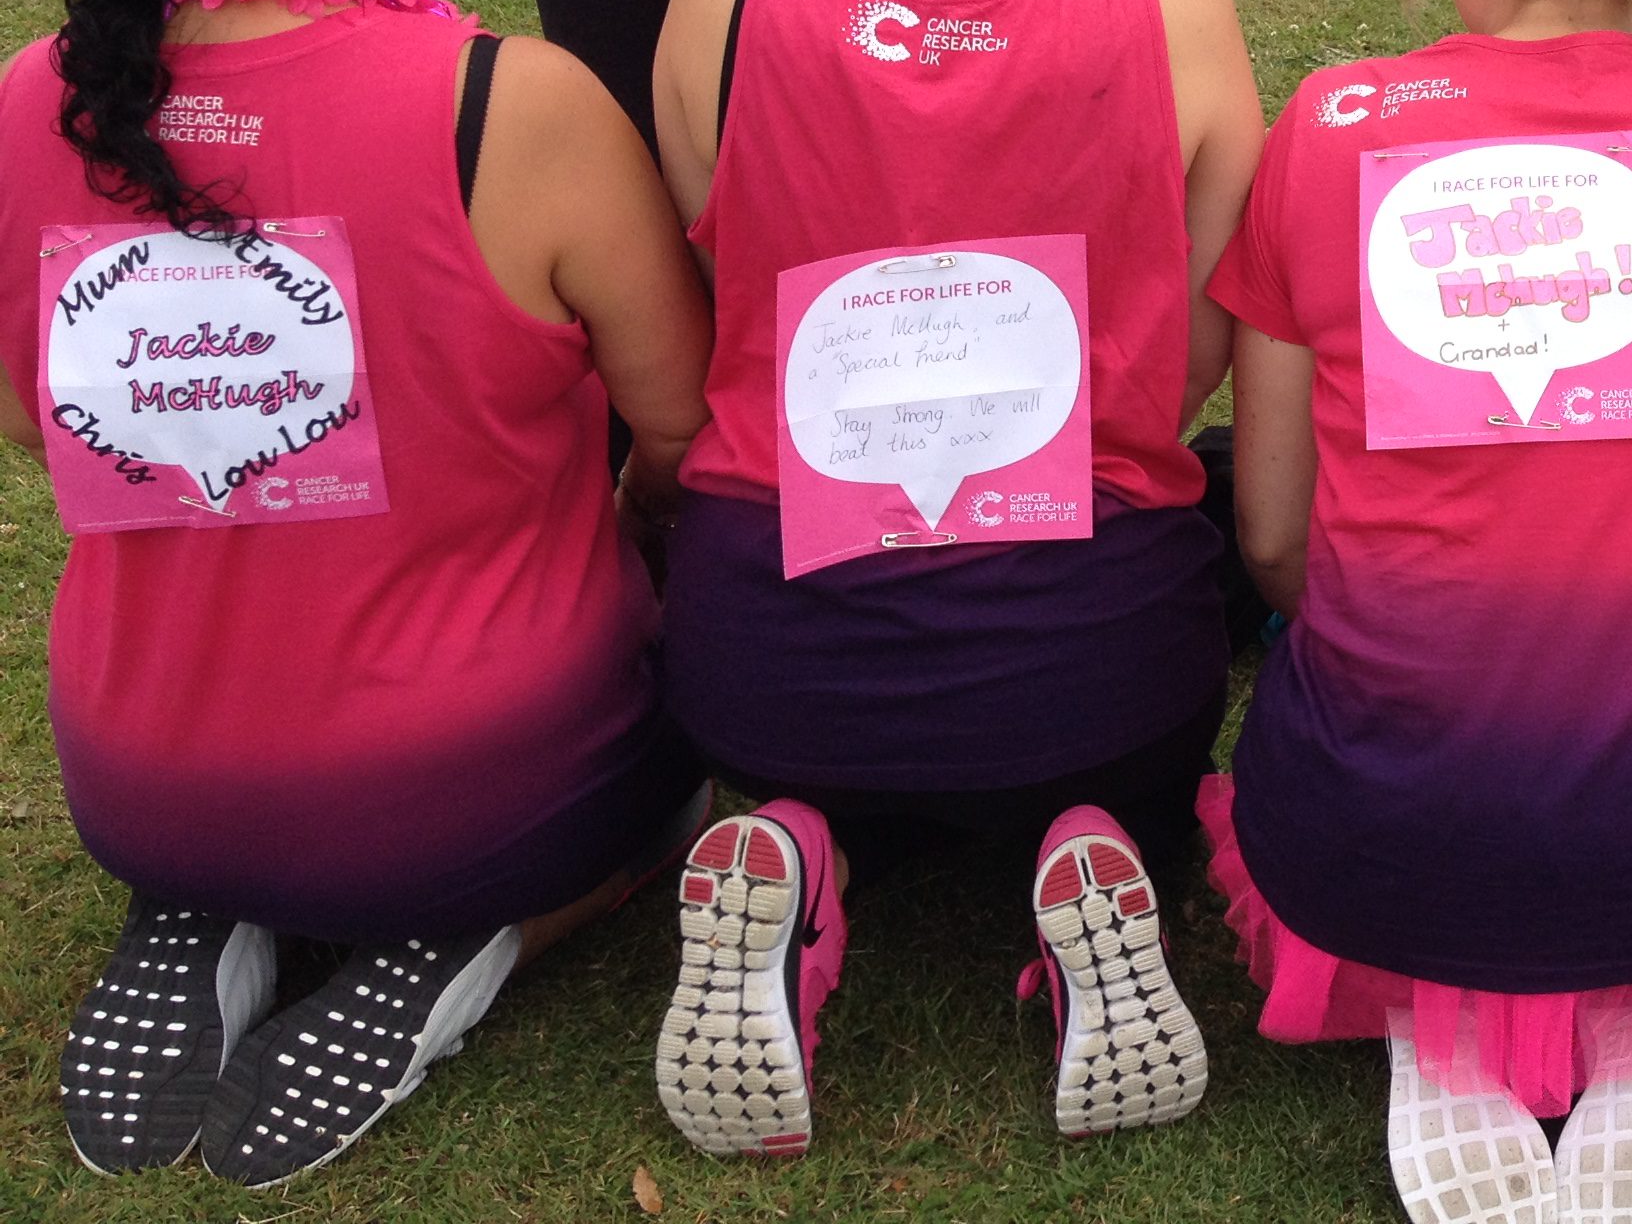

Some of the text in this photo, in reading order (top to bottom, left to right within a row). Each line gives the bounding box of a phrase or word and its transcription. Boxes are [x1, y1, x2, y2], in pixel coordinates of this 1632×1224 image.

[927, 17, 993, 36] CANCER
[922, 33, 1008, 52] RESEARCH
[918, 50, 941, 66] UK
[1384, 78, 1451, 95] CANCER
[1382, 87, 1468, 108] RESEARCH
[160, 111, 264, 130] RESEARCH UK
[1380, 105, 1400, 119] UK
[159, 127, 260, 146] RACE FOR LIFE
[1433, 174, 1599, 192] I RACE FOR LIFE FOR
[1400, 195, 1584, 269] Jackie
[164, 267, 197, 281] FOR
[202, 265, 234, 280] LIFE
[239, 264, 275, 278] FO
[234, 230, 344, 325] Emily
[57, 241, 149, 326] Mum
[843, 279, 1012, 311] I RACE FOR LIFE FOR
[812, 322, 873, 354] Jackie
[996, 302, 1033, 326] and
[115, 322, 275, 369] Jackie
[808, 370, 817, 380] a
[127, 369, 325, 416] McHugh
[830, 409, 872, 444] Stay
[970, 397, 995, 417] We
[1012, 392, 1041, 414] will
[1601, 410, 1626, 420] RACE
[51, 403, 157, 485] Chris
[829, 440, 869, 465] beat
[887, 433, 927, 453] this
[295, 475, 340, 487] CANCER
[297, 482, 369, 495] RESEARCH UK
[299, 491, 371, 505] RACE FOR LIFE
[1009, 492, 1051, 503] CANCER
[1009, 502, 1077, 513] RESEARCH UK
[1009, 512, 1077, 523] RACE FOR LIFE
